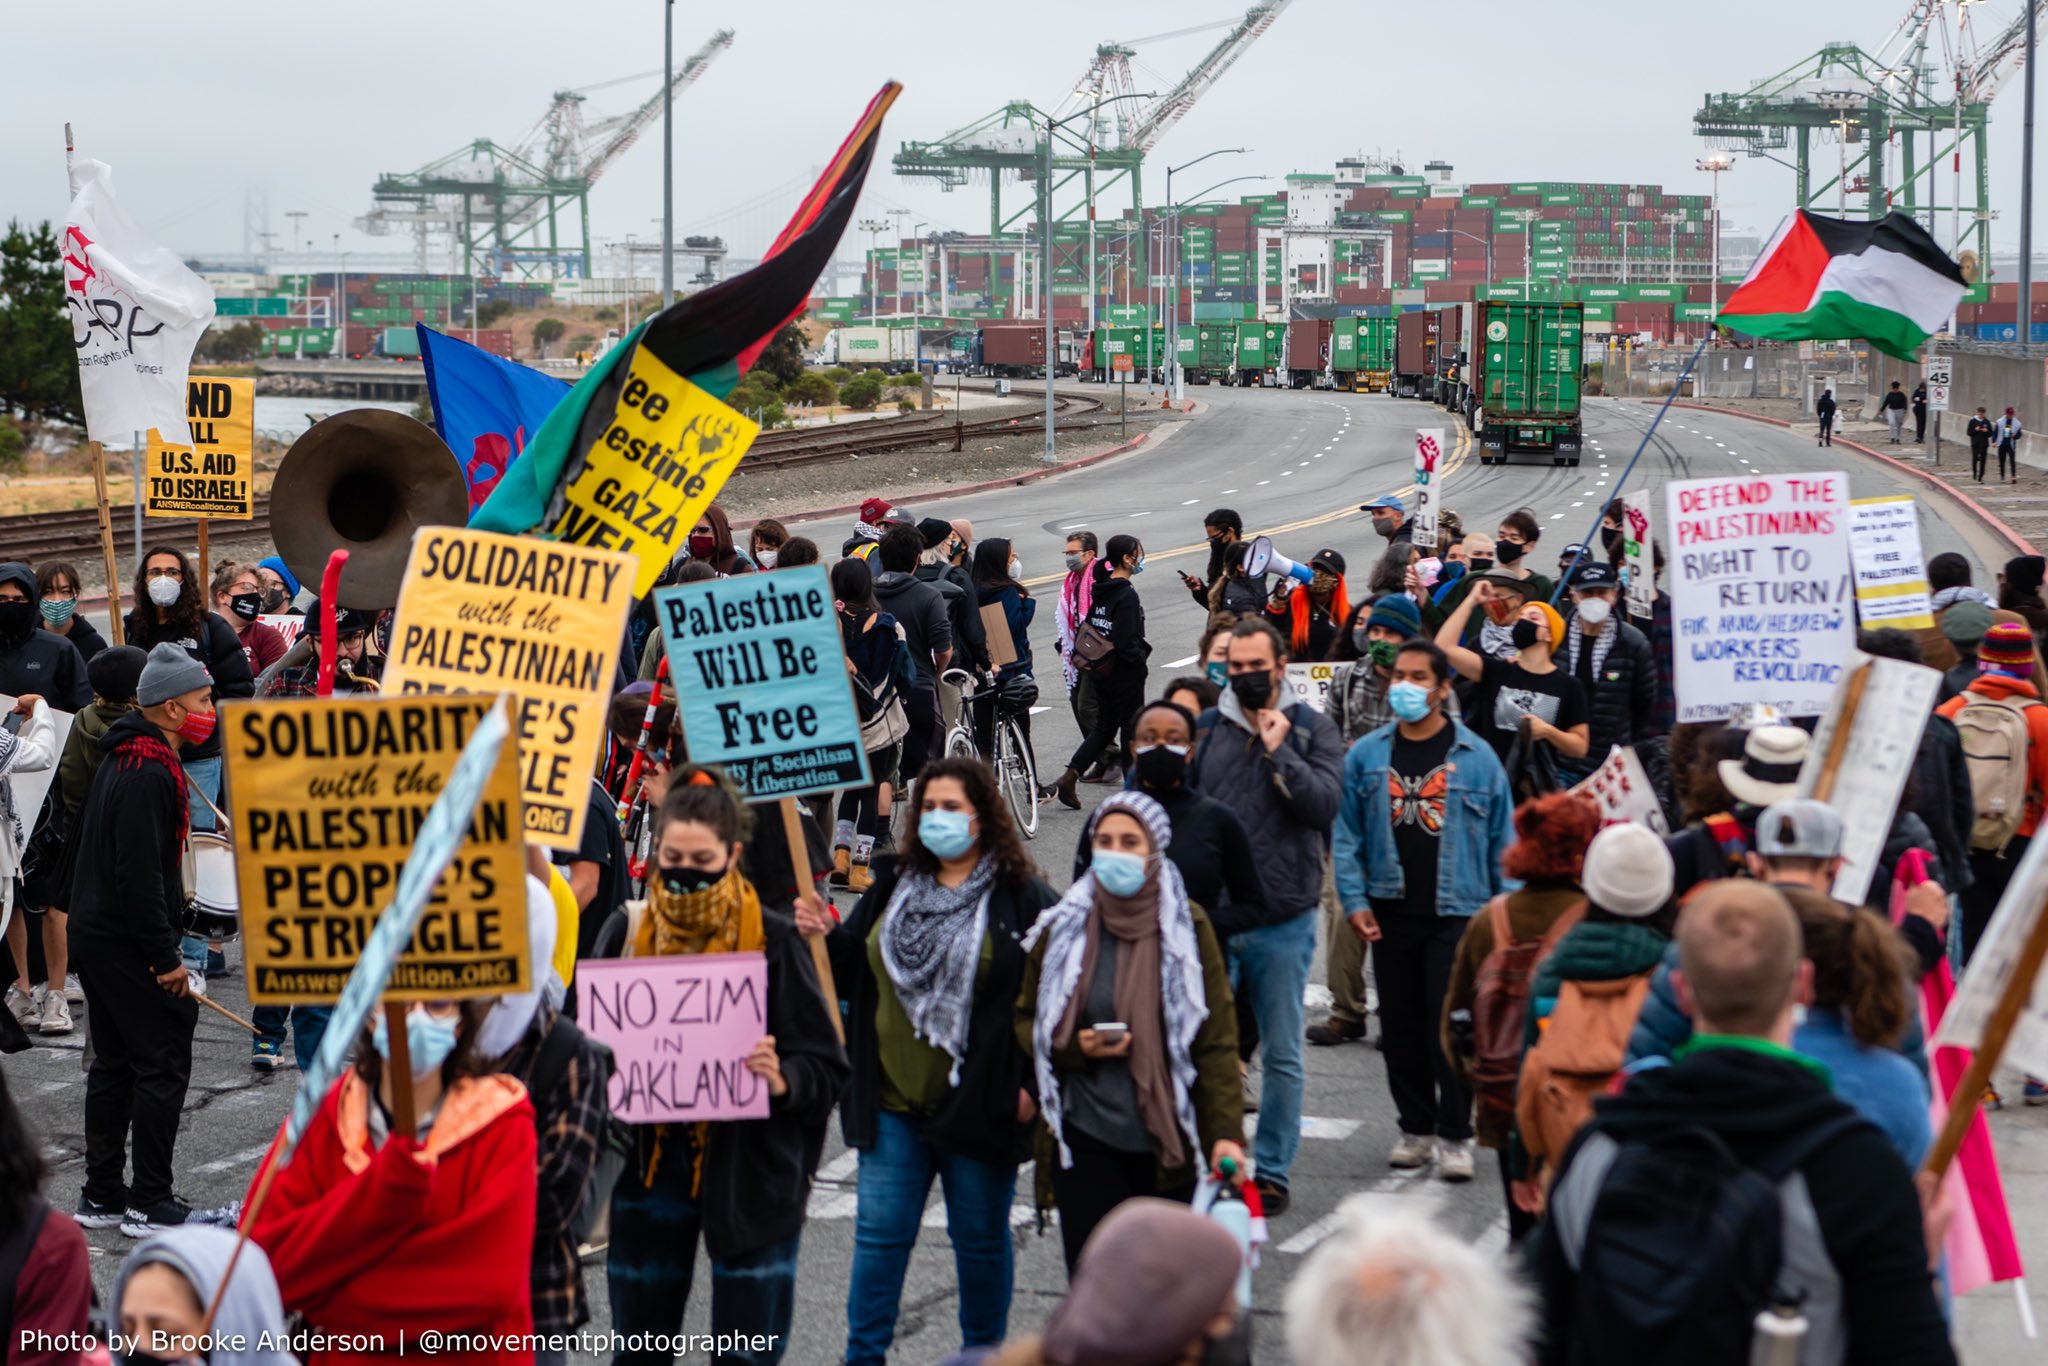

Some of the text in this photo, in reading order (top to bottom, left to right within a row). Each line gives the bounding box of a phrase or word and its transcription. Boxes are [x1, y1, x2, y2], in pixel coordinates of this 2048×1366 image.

[1929, 372, 1949, 384] 45
[185, 382, 232, 419] ND
[161, 452, 236, 475] U.S. AID
[150, 477, 246, 500] TO ISRAEL!
[156, 500, 240, 513] ANSWERcoalition.org
[1678, 479, 1836, 514] DEFEND THE
[593, 477, 679, 545] GAZA
[421, 537, 622, 604] SOLIDARITY
[1682, 546, 1812, 581] RIGHT TO
[457, 596, 562, 635] with the
[665, 581, 824, 640] Palestine
[401, 624, 604, 693] PALESTINIAN
[693, 637, 818, 690] Will Be
[1691, 638, 1801, 662] WORKERS
[715, 701, 819, 750] Free
[772, 746, 853, 774] Socialism
[308, 760, 446, 799] with the
[751, 769, 840, 796] Liberation
[590, 975, 762, 1032] NO ZIM
[654, 1033, 683, 1055] IN
